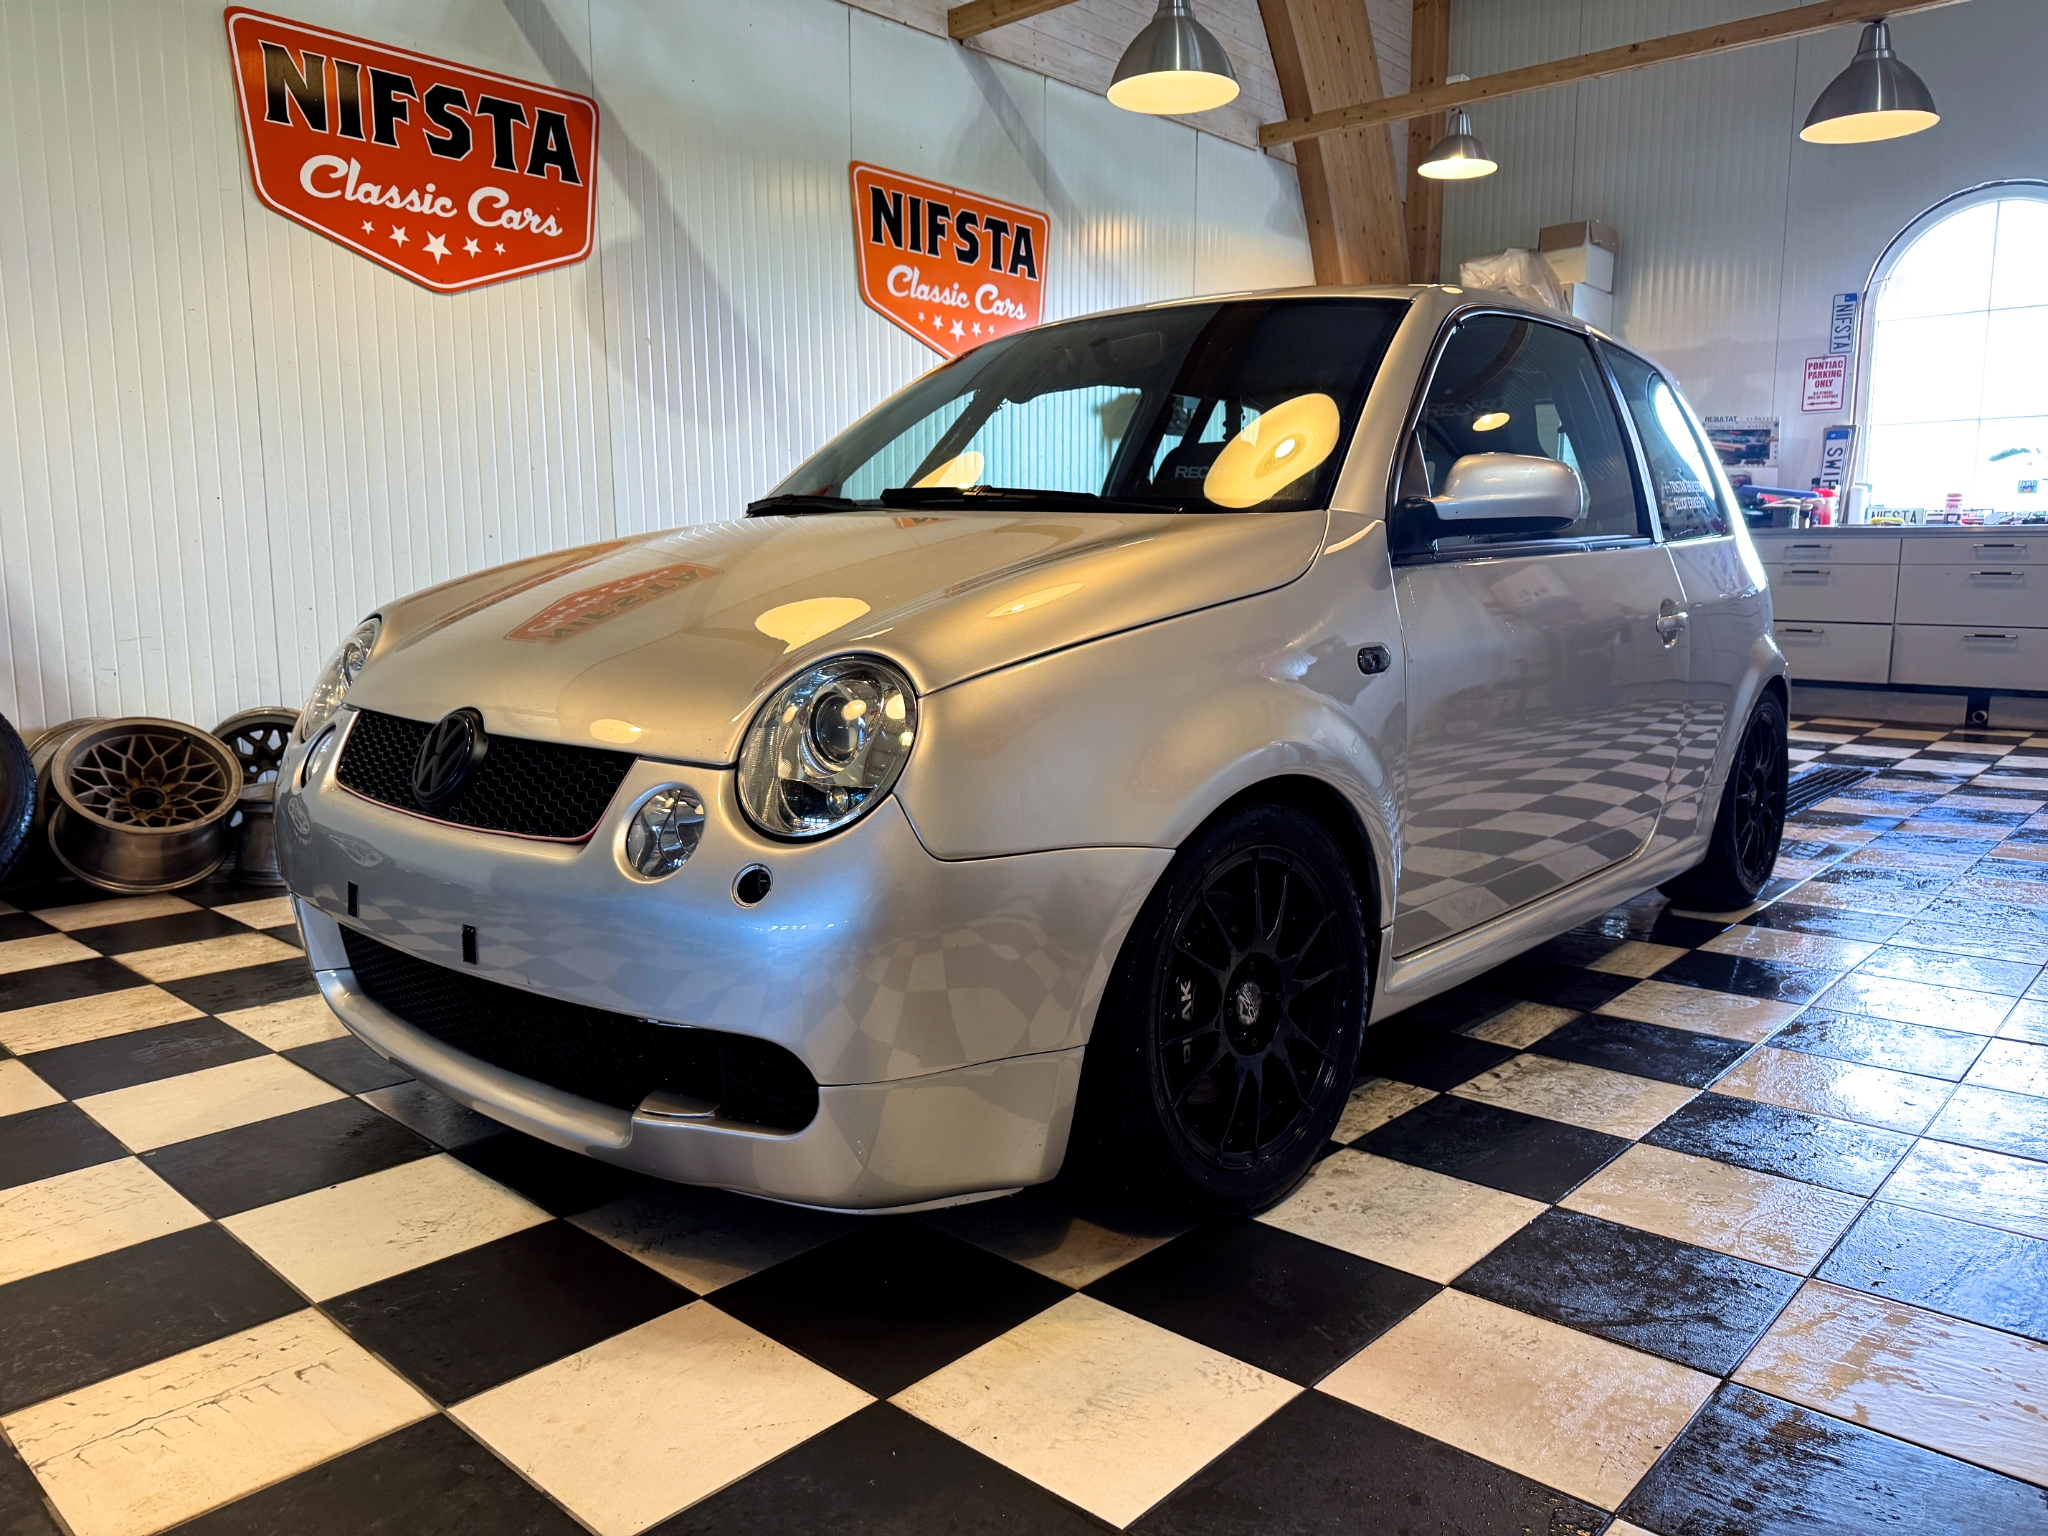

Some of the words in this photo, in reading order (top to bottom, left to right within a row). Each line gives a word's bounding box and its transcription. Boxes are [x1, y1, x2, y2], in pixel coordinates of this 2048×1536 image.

[258, 39, 584, 187] NIFSTA
[300, 154, 458, 219] Classic
[467, 186, 563, 238] Cars
[868, 184, 1039, 281] NIFSTA
[886, 264, 970, 309] Classic
[974, 283, 1027, 321] Cars
[1833, 303, 1854, 350] NIFSTA
[1807, 369, 1842, 380] PARKING
[1808, 360, 1844, 371] PONTIAC
[1814, 379, 1834, 388] ONLY
[1704, 415, 1738, 423] RESULTAT
[1180, 978, 1194, 1065] PAK
